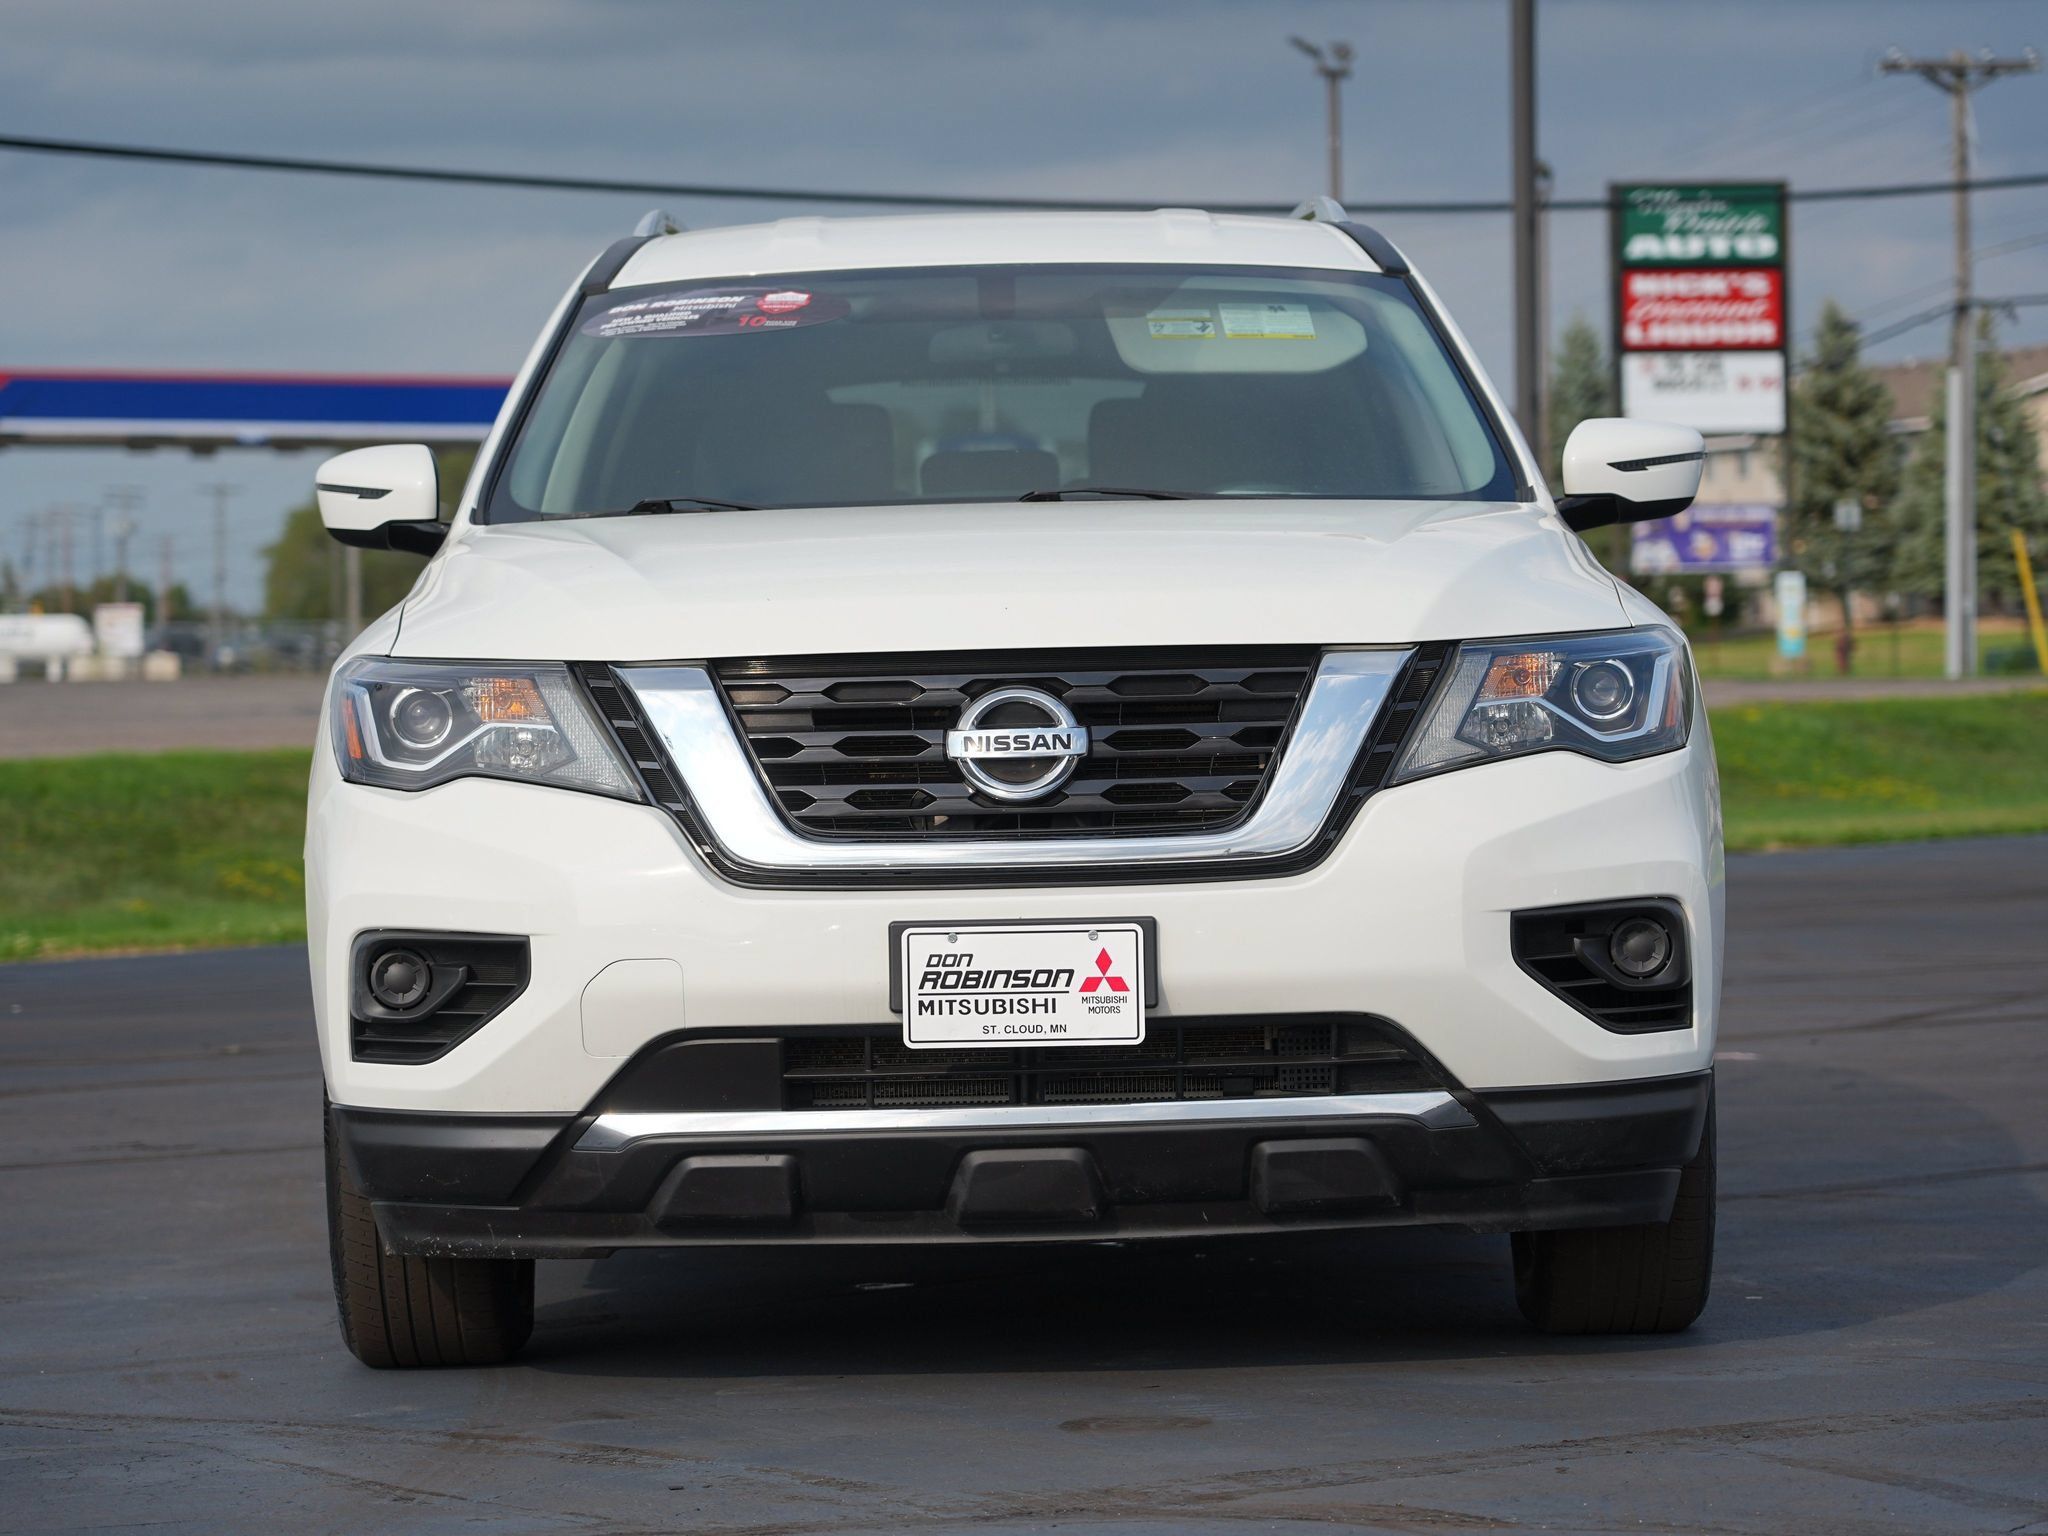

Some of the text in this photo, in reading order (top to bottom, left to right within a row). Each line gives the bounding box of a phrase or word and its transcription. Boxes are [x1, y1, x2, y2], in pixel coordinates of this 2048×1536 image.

[1624, 234, 1778, 260] AUTO
[609, 296, 745, 314] DON ROBINSON
[673, 302, 737, 311] Mitsubishi
[739, 315, 767, 327] 10
[963, 733, 1072, 753] NISSAN
[926, 953, 974, 968] DON
[918, 968, 1075, 990] ROBINSON
[918, 997, 1057, 1016] MITSUBISHI
[1081, 995, 1128, 1005] MITSUBISHI
[1088, 1005, 1121, 1015] MOTORS
[982, 1023, 1067, 1036] ST. CLOUD, MN
